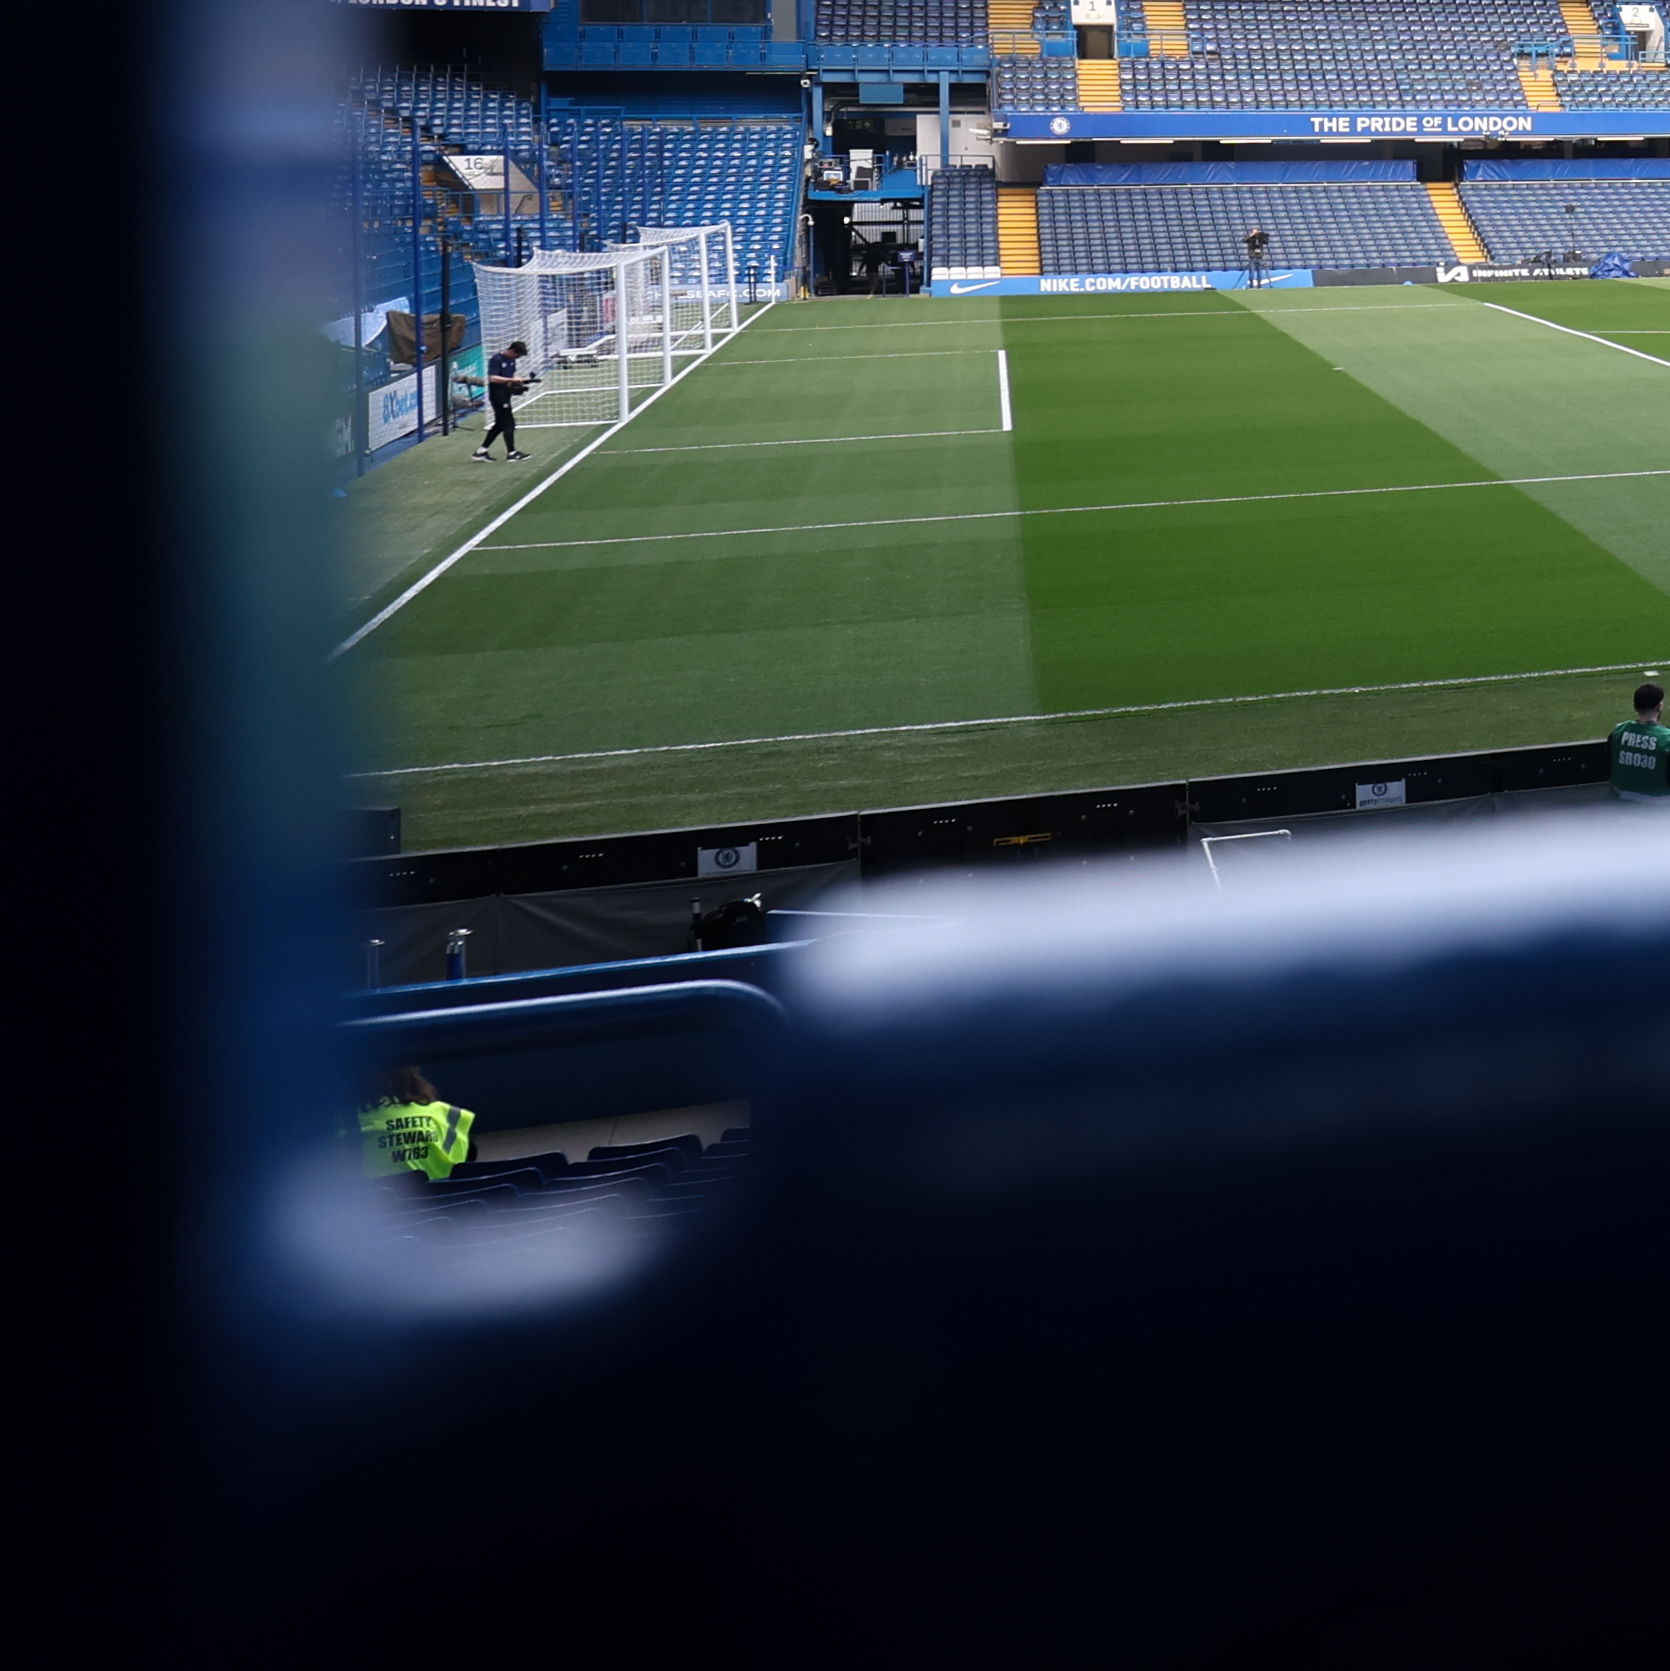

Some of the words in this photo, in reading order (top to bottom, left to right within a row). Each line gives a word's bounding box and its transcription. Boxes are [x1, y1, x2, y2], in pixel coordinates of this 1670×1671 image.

[1089, 1, 1097, 11] 1
[1632, 7, 1639, 17] 2
[1310, 117, 1350, 132] THE
[1356, 117, 1418, 132] PRIDE
[1422, 117, 1442, 128] OF
[1447, 117, 1532, 132] LONDON
[464, 157, 484, 170] 16
[1472, 268, 1529, 278] INFINITE
[1040, 275, 1212, 293] NIKE.COM/FOOTBALL
[1621, 731, 1658, 751] PRESS
[1618, 750, 1656, 770] SB030
[386, 1116, 432, 1132] SAFETY
